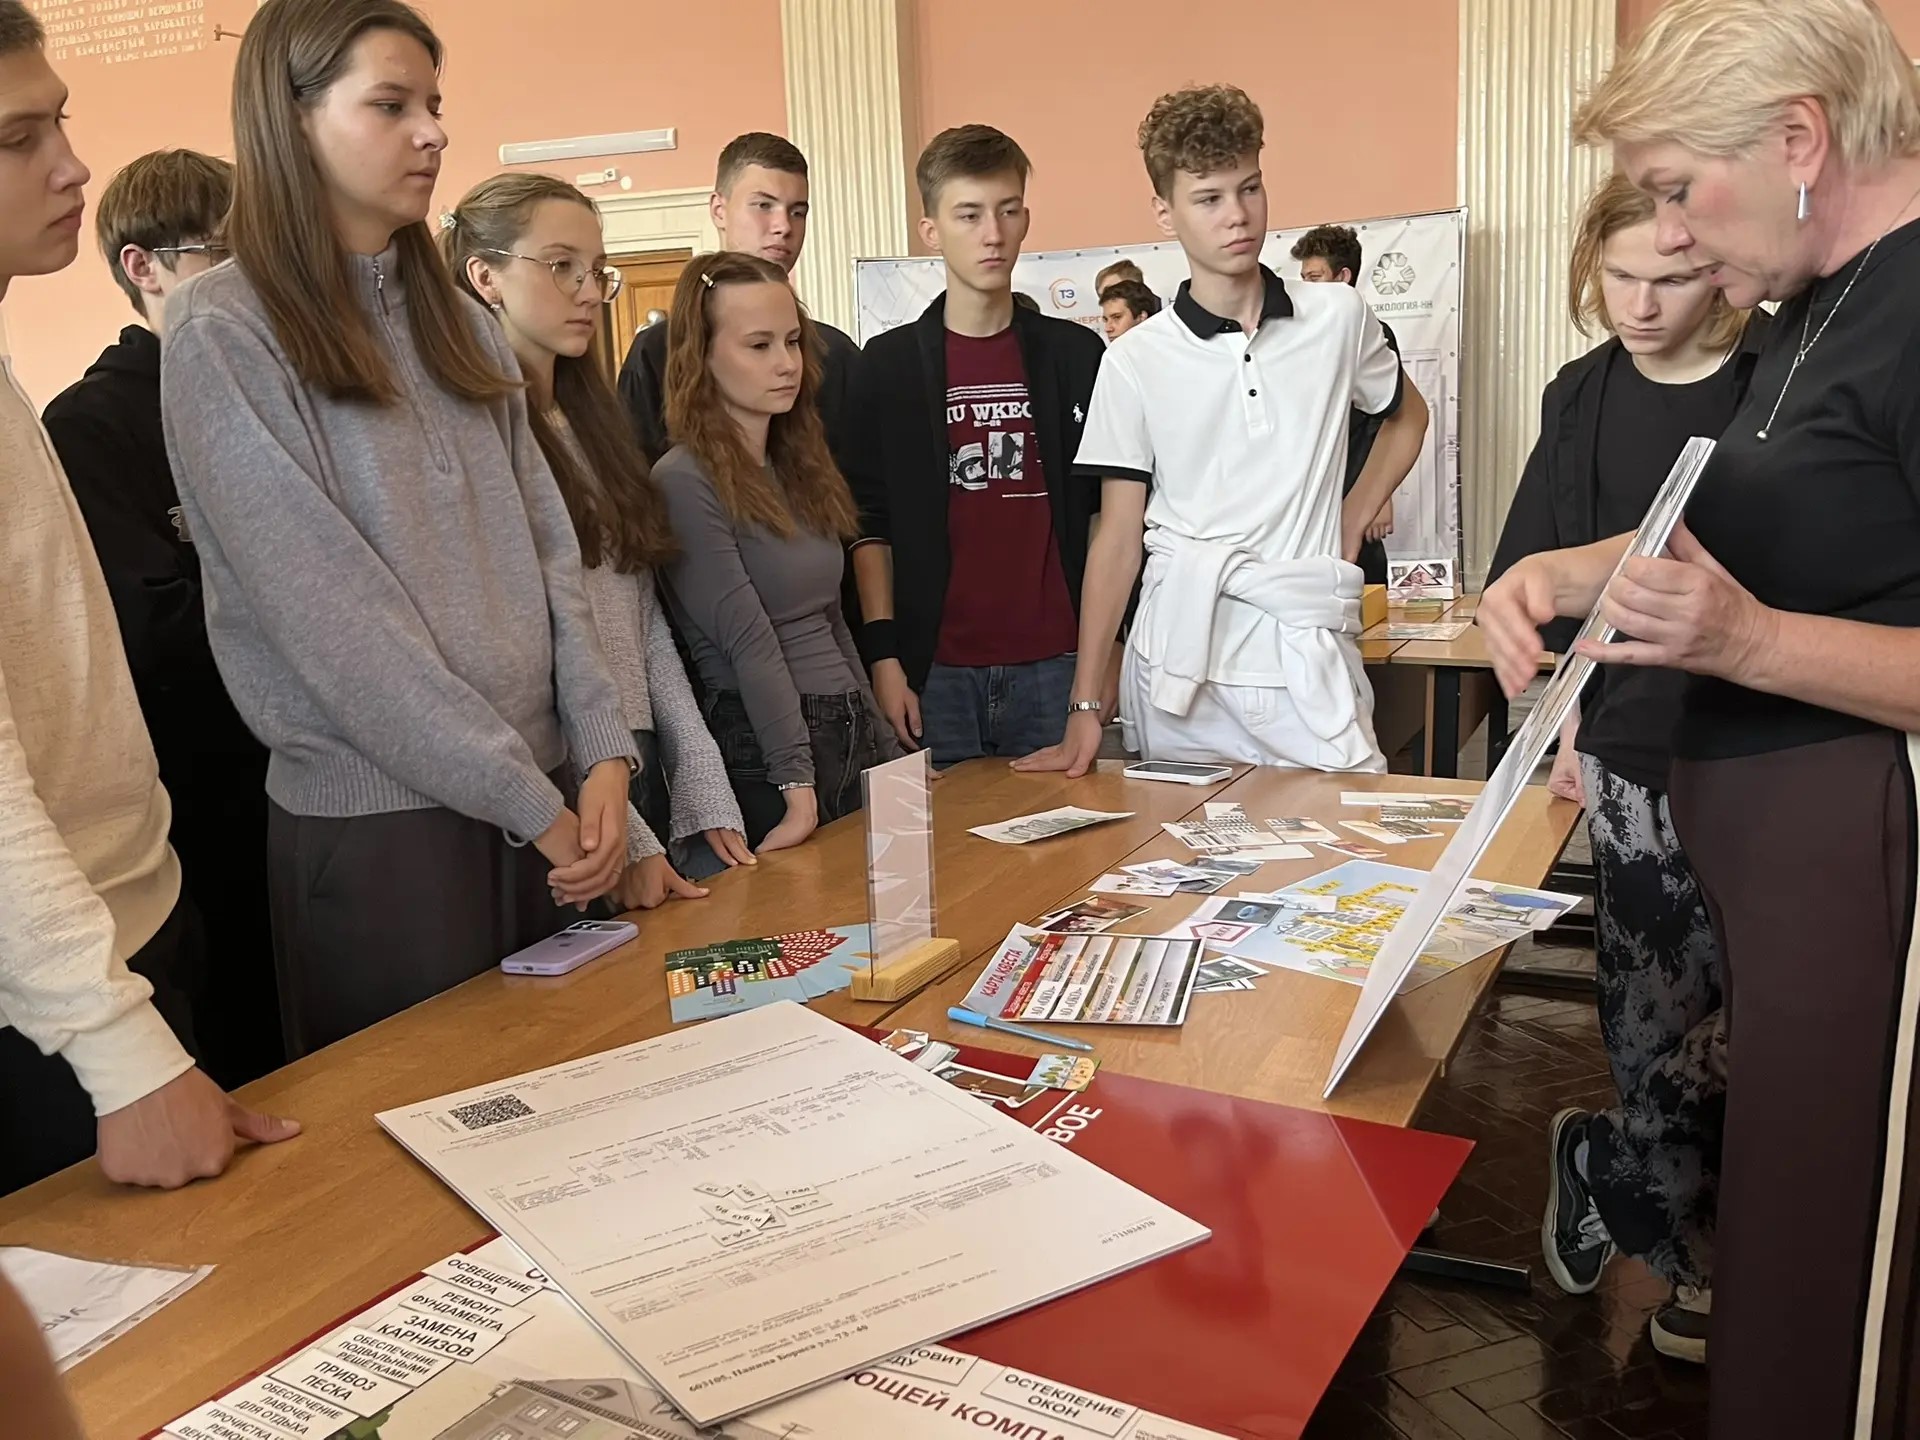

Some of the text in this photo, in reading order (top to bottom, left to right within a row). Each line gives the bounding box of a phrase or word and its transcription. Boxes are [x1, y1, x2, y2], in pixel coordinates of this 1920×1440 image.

[1059, 289, 1075, 299] ТЭ
[1371, 301, 1433, 312] ЭКОЛОГИЯ-НН
[980, 948, 1023, 998] КАРТА КВЕСТА
[1047, 1103, 1103, 1144] ВОЕ
[448, 1258, 535, 1294] ОСВЕЩЕНИЕ
[448, 1273, 498, 1296] ДВОРА
[411, 1294, 504, 1333] ФУНДАМЕНТА
[441, 1291, 502, 1316] РЕМОНТ
[377, 1323, 474, 1358] КАРНИЗОВ
[404, 1315, 478, 1344] ЗАМЕНА
[338, 1340, 431, 1376] ПОДВАЛЬНЫМИ
[353, 1333, 438, 1368] ОБЕСПЕЧЕНИЕ
[301, 1375, 353, 1401] ПЕСКА
[314, 1361, 378, 1392] ПРИВОЗ
[259, 1396, 317, 1422] ЛАВОЧЕК
[261, 1382, 343, 1420] ОБЕСПЕЧЕНИЕ
[1004, 1373, 1126, 1419] ОСТЕКЛЕНИЕ
[1027, 1395, 1082, 1419] ОКОН
[206, 1408, 273, 1440] ПРОЧИСТКА
[234, 1400, 309, 1436] ДЛЯ ОТДЫХА
